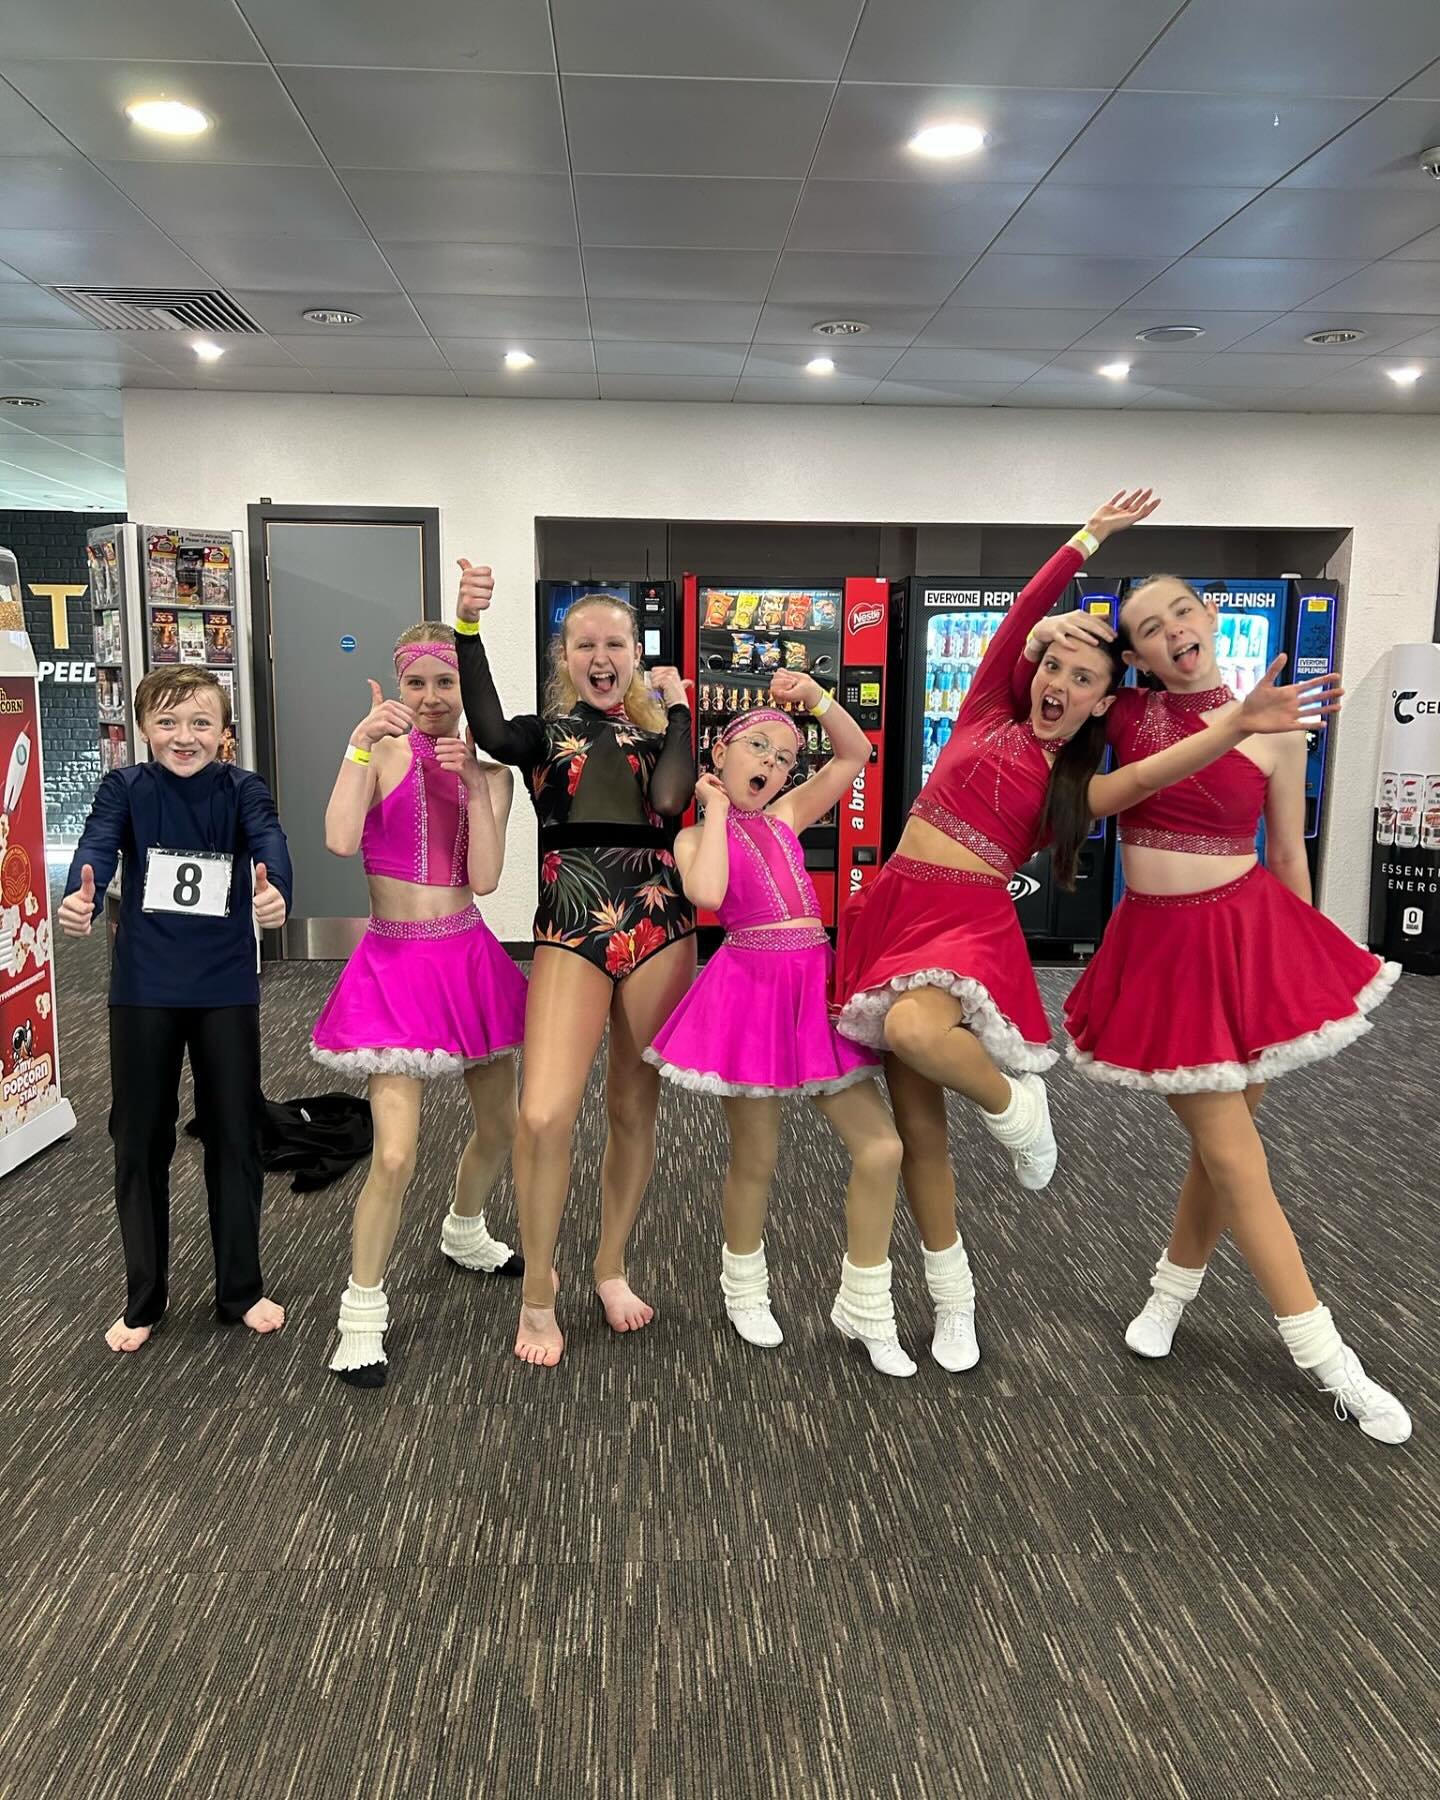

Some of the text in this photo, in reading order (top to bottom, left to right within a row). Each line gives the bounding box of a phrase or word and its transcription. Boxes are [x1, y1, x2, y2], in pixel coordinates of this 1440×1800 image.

[927, 591, 1022, 607] EVERYONE REPL
[1203, 592, 1276, 608] REPLENISH
[173, 862, 203, 907] 8
[1388, 879, 1437, 893] ENERG
[2, 1060, 50, 1102] POPCORN
